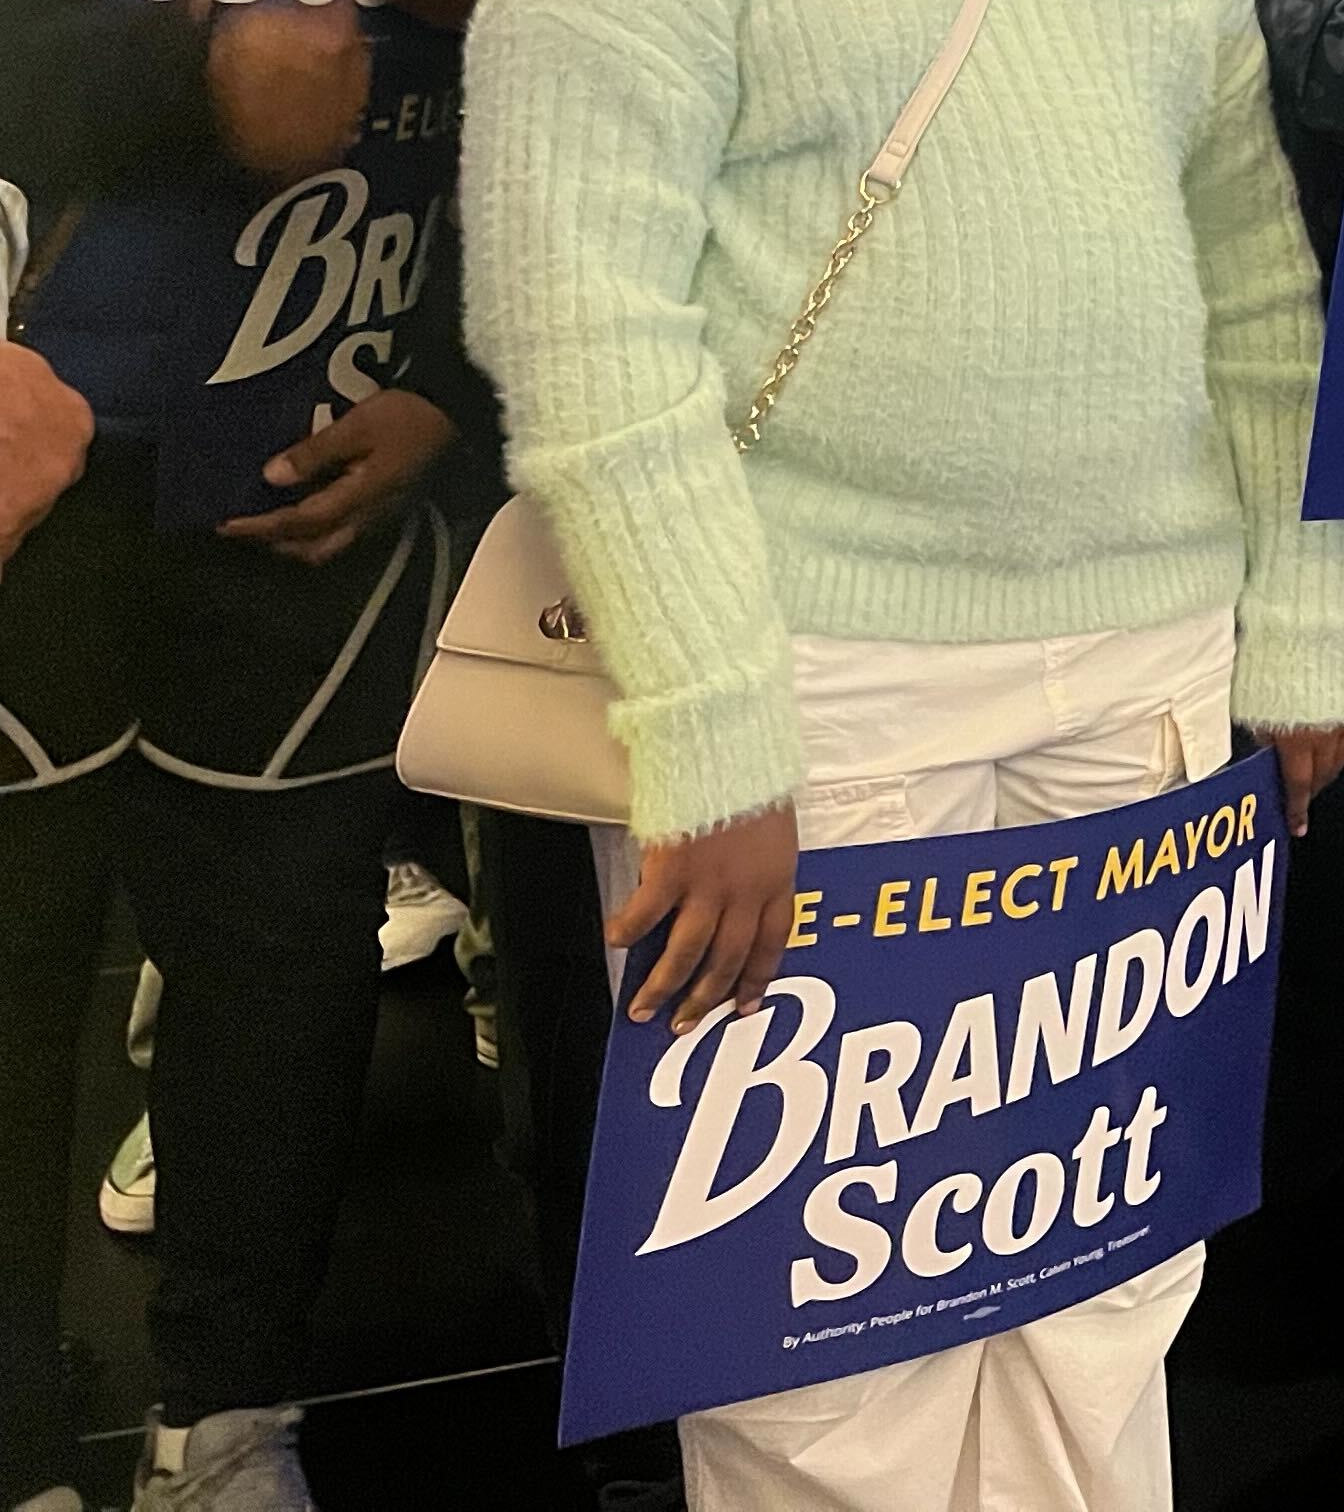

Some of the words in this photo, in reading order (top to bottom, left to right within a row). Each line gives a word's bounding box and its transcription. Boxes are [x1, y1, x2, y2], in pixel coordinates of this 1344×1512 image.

[786, 855, 1079, 949] E-ELECT
[1097, 793, 1257, 900] MAYOR
[635, 839, 1276, 1256] BRANDON
[791, 1086, 1168, 1309] Scott
[783, 1336, 800, 1350] By
[870, 1309, 913, 1329] People
[915, 1303, 935, 1317] for
